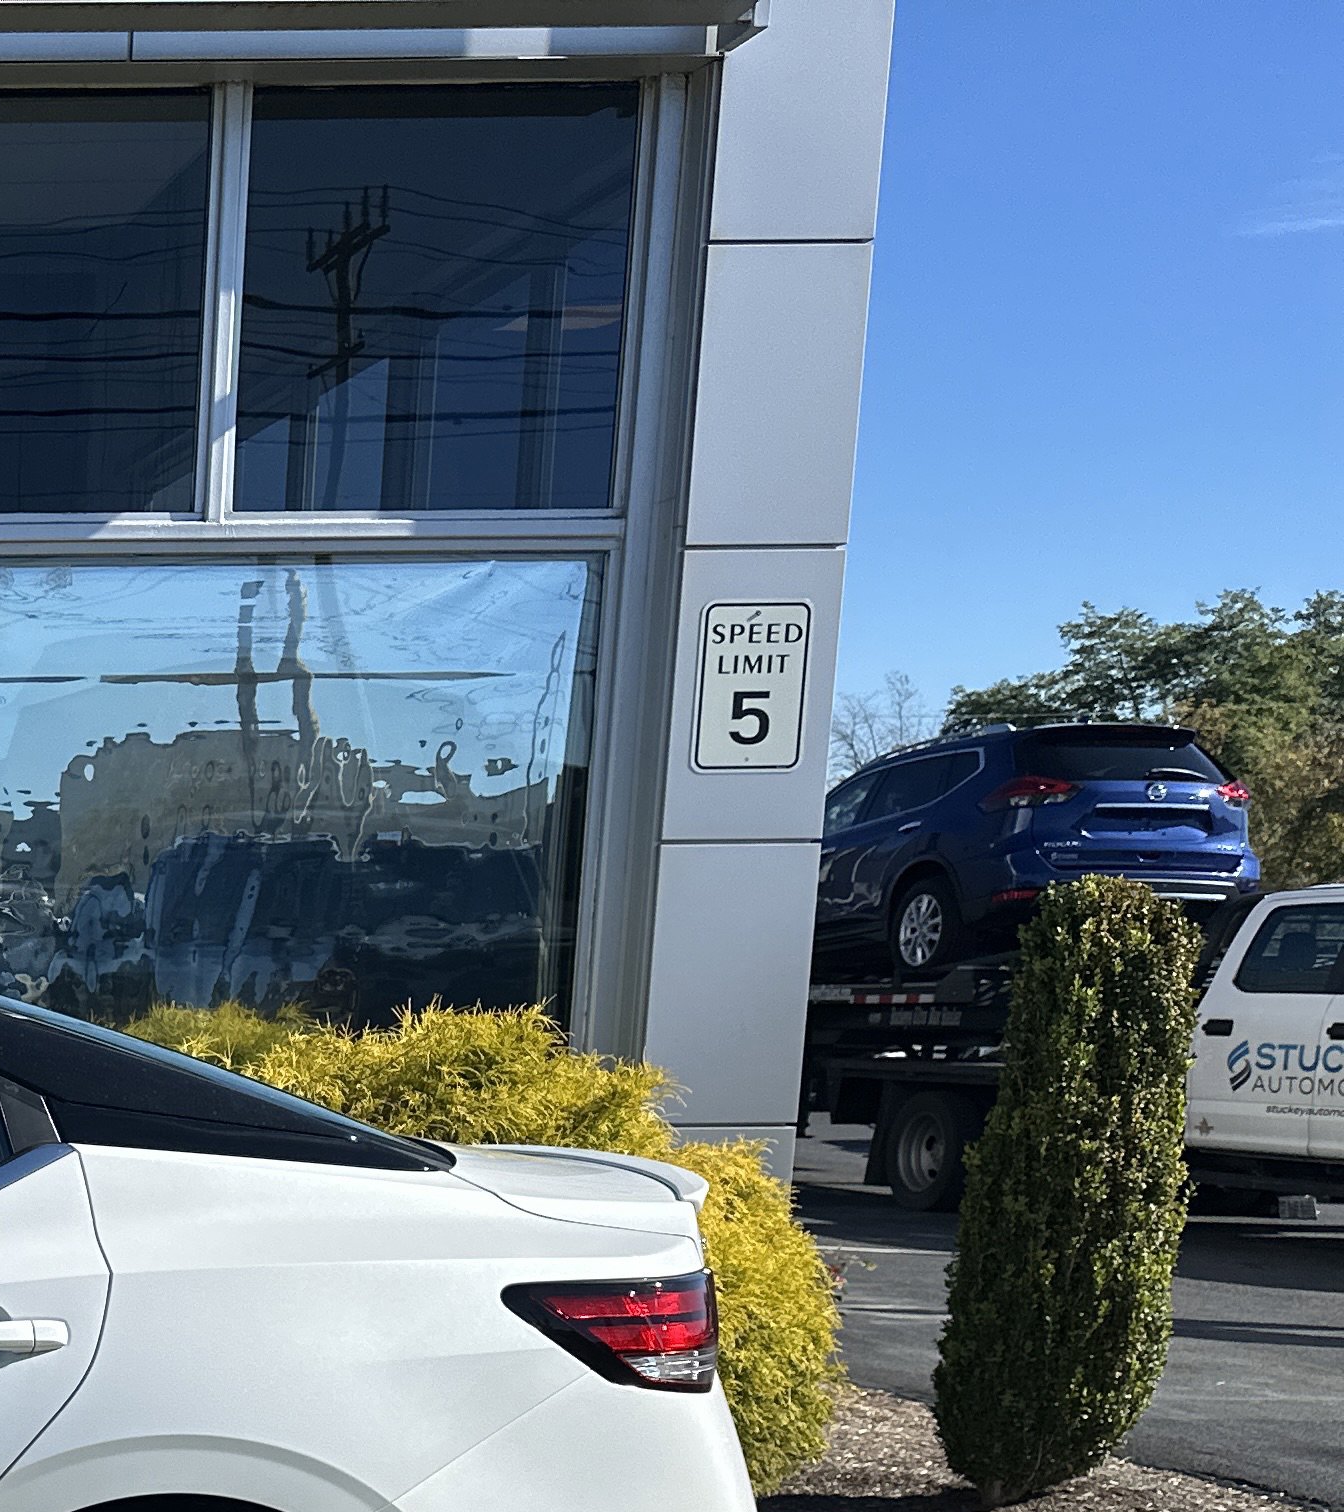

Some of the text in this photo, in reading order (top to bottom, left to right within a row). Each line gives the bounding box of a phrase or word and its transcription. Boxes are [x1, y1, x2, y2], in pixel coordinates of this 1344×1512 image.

[712, 623, 804, 644] SPEED
[718, 654, 790, 674] LIMIT
[729, 691, 771, 745] 5
